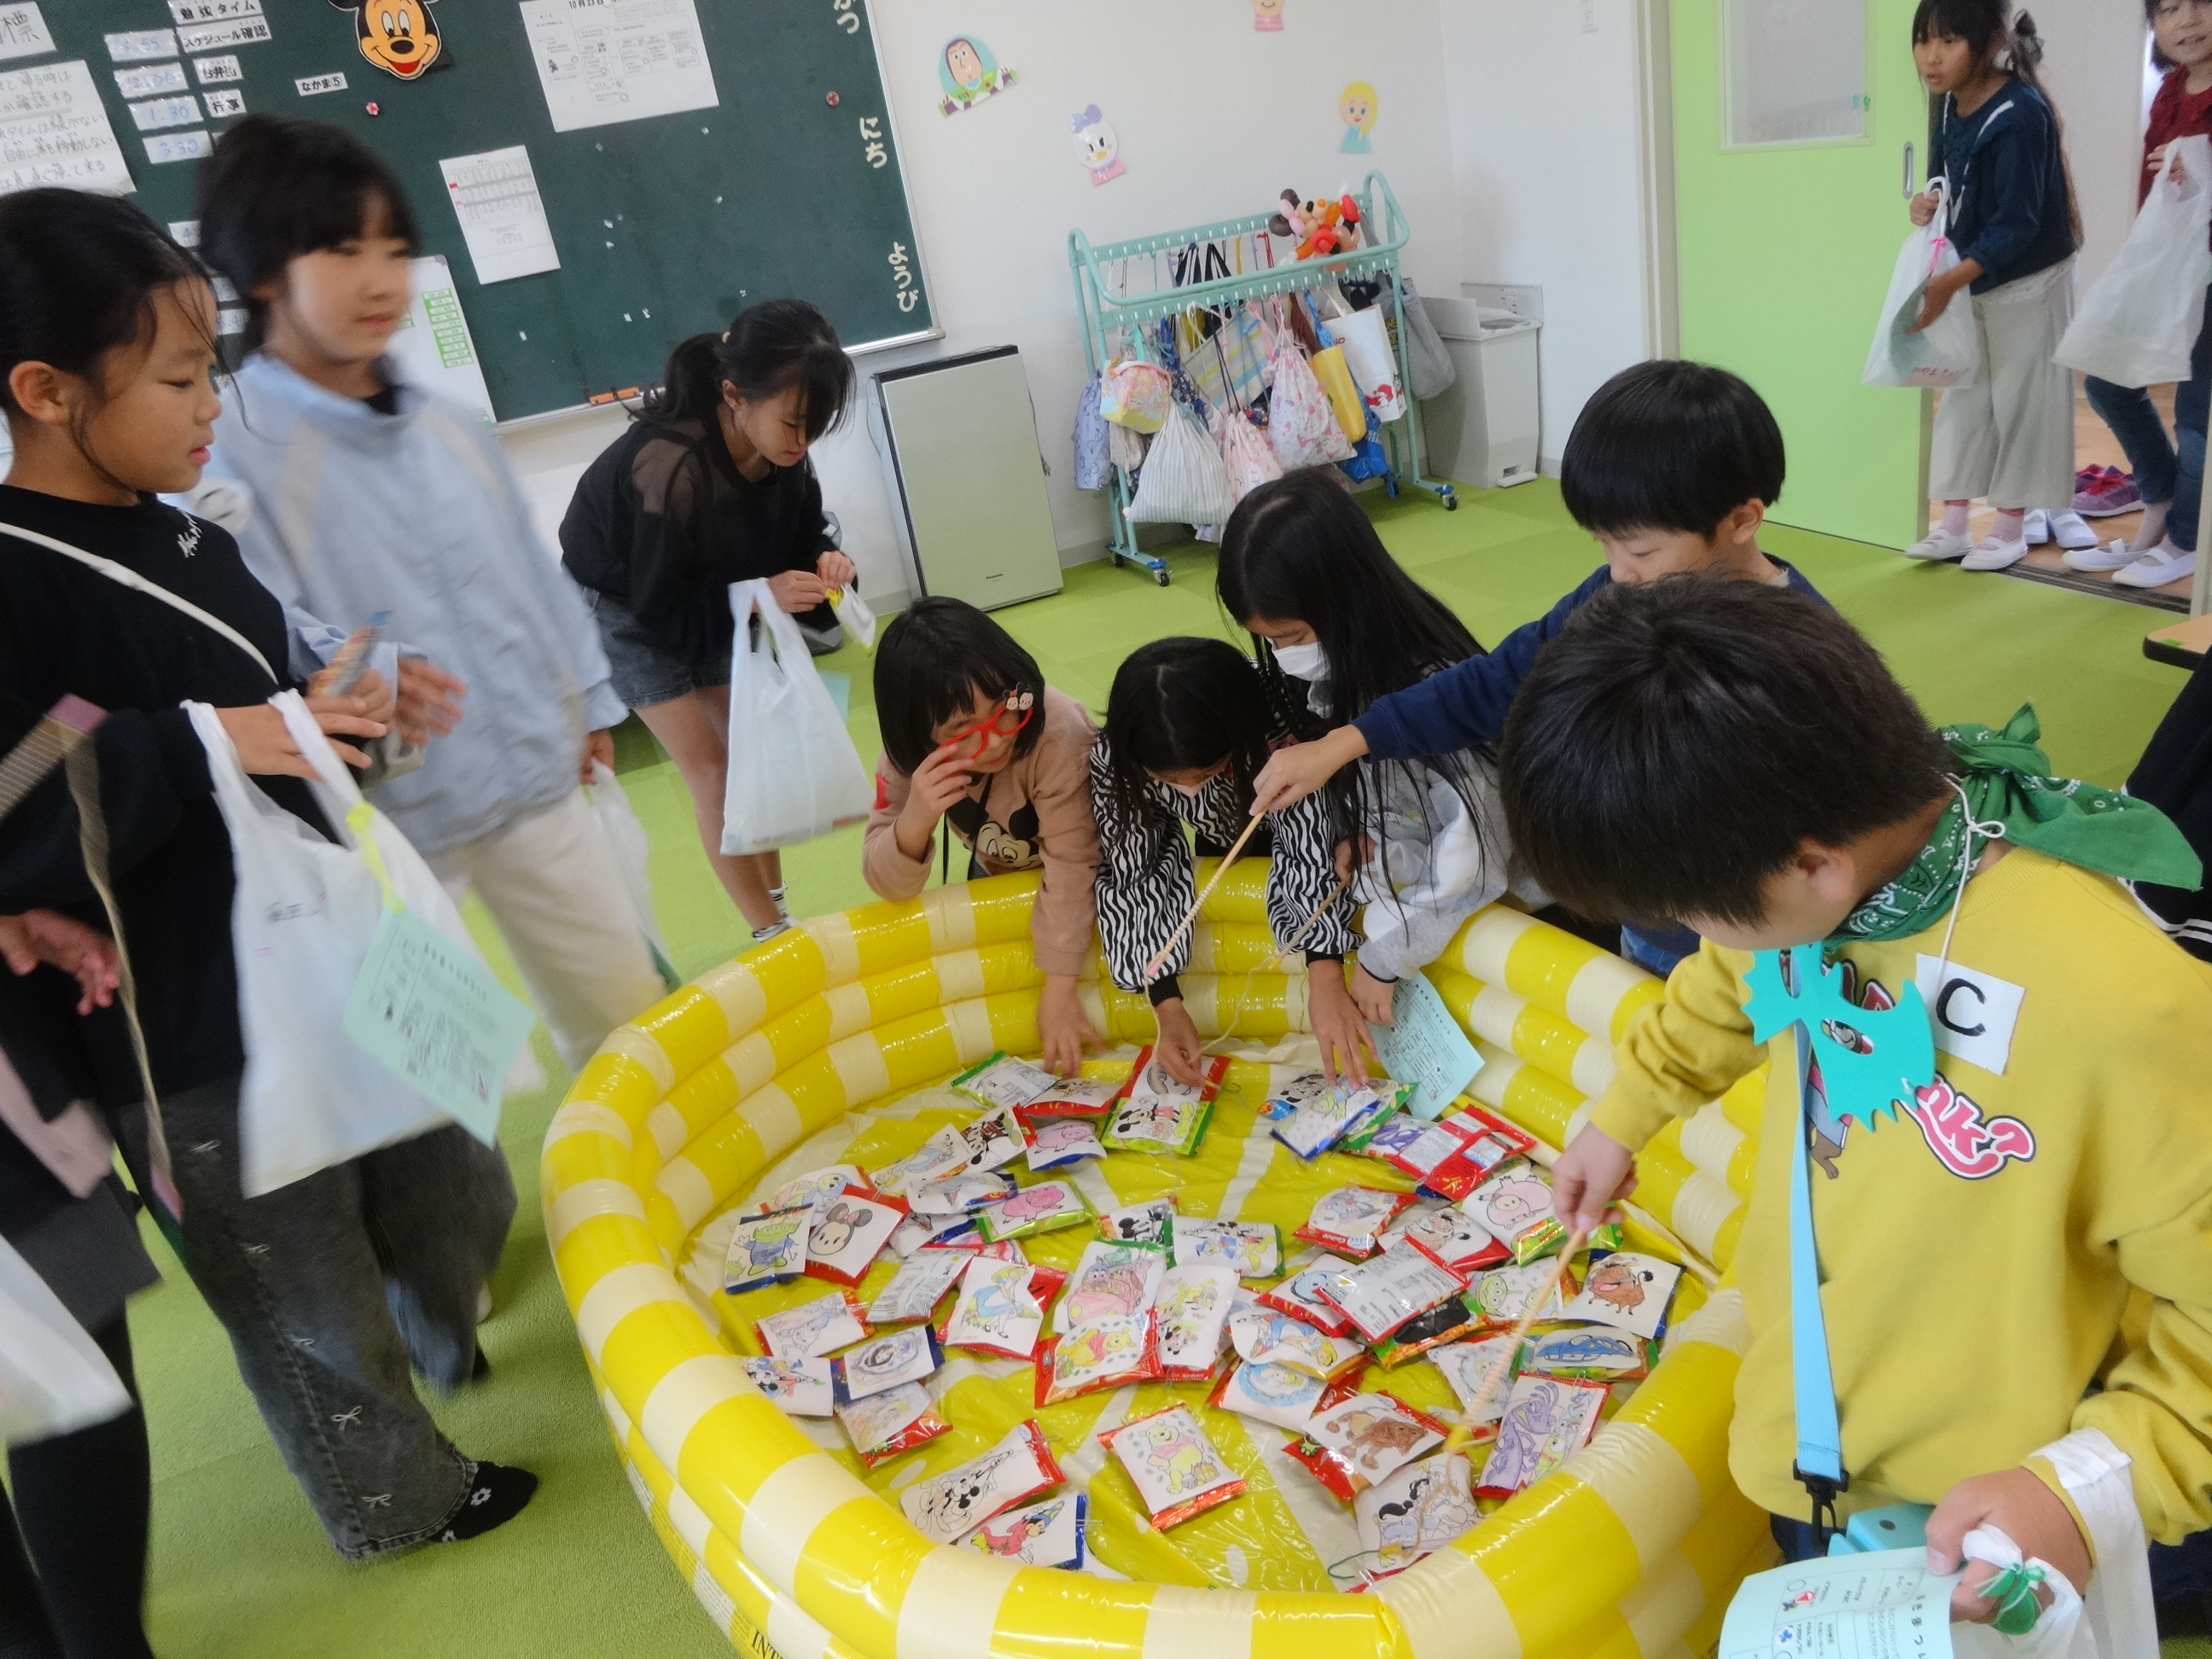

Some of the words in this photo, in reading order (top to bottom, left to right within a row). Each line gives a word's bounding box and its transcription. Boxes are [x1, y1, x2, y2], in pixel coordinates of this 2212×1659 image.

[183, 25, 269, 49] スケジュール確認
[859, 117, 888, 169] にち
[888, 242, 920, 312] ようび
[1935, 977, 1987, 1038] C
